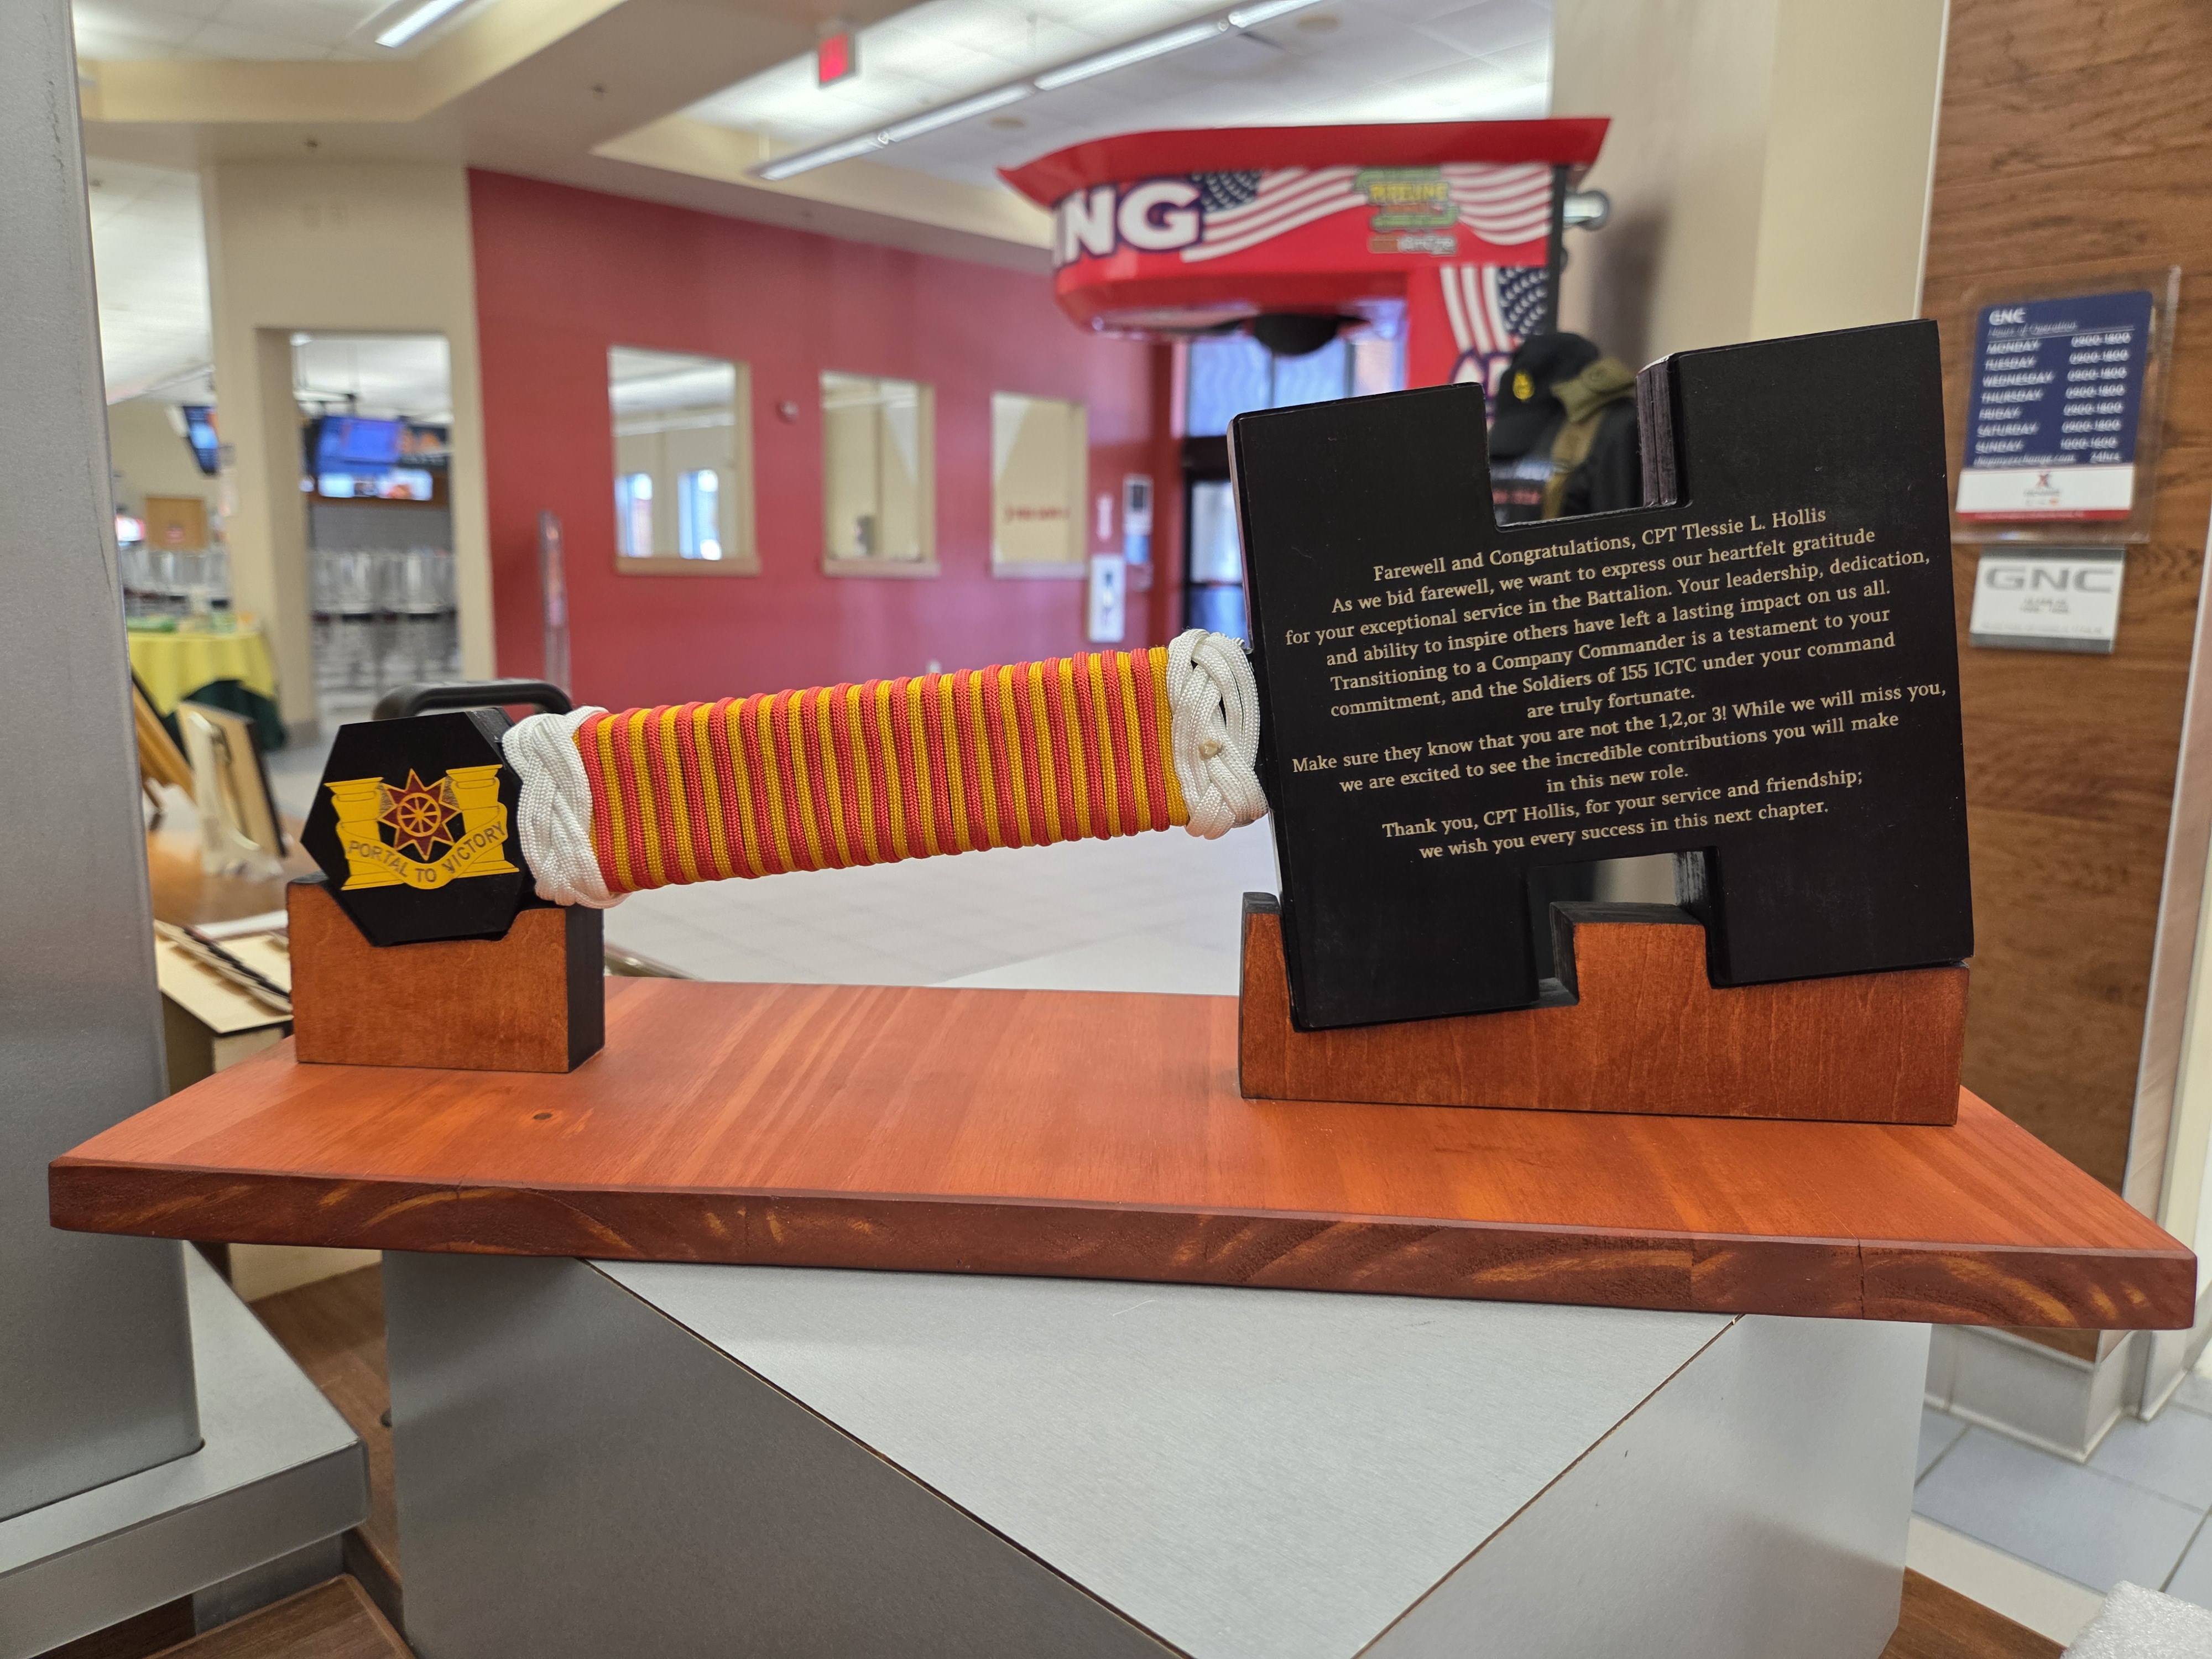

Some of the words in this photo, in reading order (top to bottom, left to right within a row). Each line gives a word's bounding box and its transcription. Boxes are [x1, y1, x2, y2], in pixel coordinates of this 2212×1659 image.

[1331, 598, 1353, 613] As
[1357, 596, 1381, 609] we
[1385, 587, 1415, 606] bid
[1420, 577, 1495, 602] farewell,
[1499, 577, 1524, 591] we
[1527, 569, 1572, 587] want
[1577, 567, 1596, 581] to
[1601, 559, 1666, 580] express
[1672, 554, 1703, 568] our
[1707, 539, 1786, 564] heartfelt
[1792, 528, 1875, 557] gratitude
[1373, 557, 1447, 581] Farewell
[1452, 552, 1484, 571] and
[1489, 536, 1636, 566] Congratulations,
[1642, 526, 1677, 546] CPT
[1750, 515, 1766, 531] L.
[1772, 507, 1826, 528] Hollis
[1985, 566, 2114, 593] GNC
[1285, 629, 1311, 645] for
[1314, 625, 1355, 646] your
[1360, 608, 1458, 635] exceptional
[1463, 603, 1523, 622] service
[1528, 599, 1547, 614] in
[1551, 594, 1582, 611] the
[1587, 584, 1672, 606] Battalion.
[1676, 578, 1720, 594] Your
[1726, 563, 1823, 588] leadership,
[1829, 551, 1929, 575] dedication,
[1327, 647, 1359, 666] and
[1364, 642, 1419, 661] ability
[1423, 640, 1442, 653] to
[1447, 631, 1507, 651] inspire
[1513, 624, 1568, 641] others
[1573, 619, 1615, 634] have
[1619, 610, 1651, 628] left
[1657, 612, 1667, 624] a
[1672, 602, 1734, 622] lasting
[1740, 592, 1802, 614] impact
[1807, 591, 1831, 604] on
[1835, 587, 1857, 600] us
[1864, 579, 1890, 597] all.
[1330, 665, 1448, 691] Transitioning
[1452, 662, 1471, 676] to
[1477, 661, 1487, 673] a
[1492, 650, 1573, 670] Company
[1578, 634, 1686, 659] Commander
[1691, 630, 1707, 646] is
[1713, 631, 1723, 643] a
[1728, 617, 1819, 640] testament
[1824, 615, 1843, 628] to
[1848, 609, 1890, 630] your
[1331, 691, 1446, 717] commitment,
[1451, 684, 1484, 702] and
[1488, 681, 1518, 697] the
[1522, 674, 1593, 693] Soldiers
[1597, 666, 1616, 684] of
[1620, 663, 1648, 681] 155
[1653, 656, 1697, 677] ICTC
[1702, 651, 1755, 670] under
[1759, 647, 1802, 667] your
[1807, 631, 1896, 658] command
[1292, 755, 1337, 773] Make
[1343, 753, 1379, 766] sure
[1383, 746, 1423, 763] they
[1427, 740, 1473, 757] know
[1478, 734, 1515, 750] that
[1519, 731, 1552, 749] you
[1557, 727, 1584, 740] are
[1589, 721, 1620, 737] not
[1624, 716, 1654, 732] the
[1712, 705, 1727, 722] 3!
[1731, 699, 1785, 719] While
[1790, 699, 1815, 712] we
[1819, 689, 1854, 708] will
[1860, 686, 1902, 703] miss
[1906, 683, 1946, 702] you,
[1527, 705, 1554, 718] are
[1558, 696, 1603, 714] truly
[1607, 687, 1695, 708] fortunate.
[1339, 780, 1363, 792] we
[1369, 776, 1395, 789] are
[1400, 764, 1461, 785] excited
[1465, 764, 1484, 778] to
[1489, 761, 1516, 775] see
[1521, 755, 1551, 770] the
[1556, 743, 1642, 766] incredible
[1648, 731, 1767, 755] contributions
[1772, 726, 1806, 744] you
[1811, 717, 1844, 735] will
[1850, 712, 1899, 731] make
[1546, 779, 1566, 793] in
[1569, 774, 1604, 790] this
[1609, 771, 1645, 786] new
[1650, 763, 1688, 781] role.
[1381, 818, 1438, 837] Thank
[1441, 817, 1479, 835] you,
[1483, 808, 1517, 826] CPT
[1522, 802, 1580, 821] Hollis,
[1585, 799, 1611, 814] for
[1615, 796, 1656, 815] your
[1661, 787, 1721, 806] service
[1727, 779, 1760, 797] and
[1766, 769, 1862, 793] friendship;
[1418, 846, 1443, 859] we
[1447, 837, 1489, 855] wish
[1491, 837, 1525, 854] you
[1530, 831, 1576, 846] every
[1582, 823, 1645, 840] success
[1650, 818, 1668, 832] in
[1673, 813, 1708, 830] this
[1714, 808, 1752, 825] next
[1758, 801, 1828, 821] chapter.
[347, 839, 408, 878] PORTAL
[415, 867, 437, 883] TO
[441, 821, 506, 874] VICTORY
